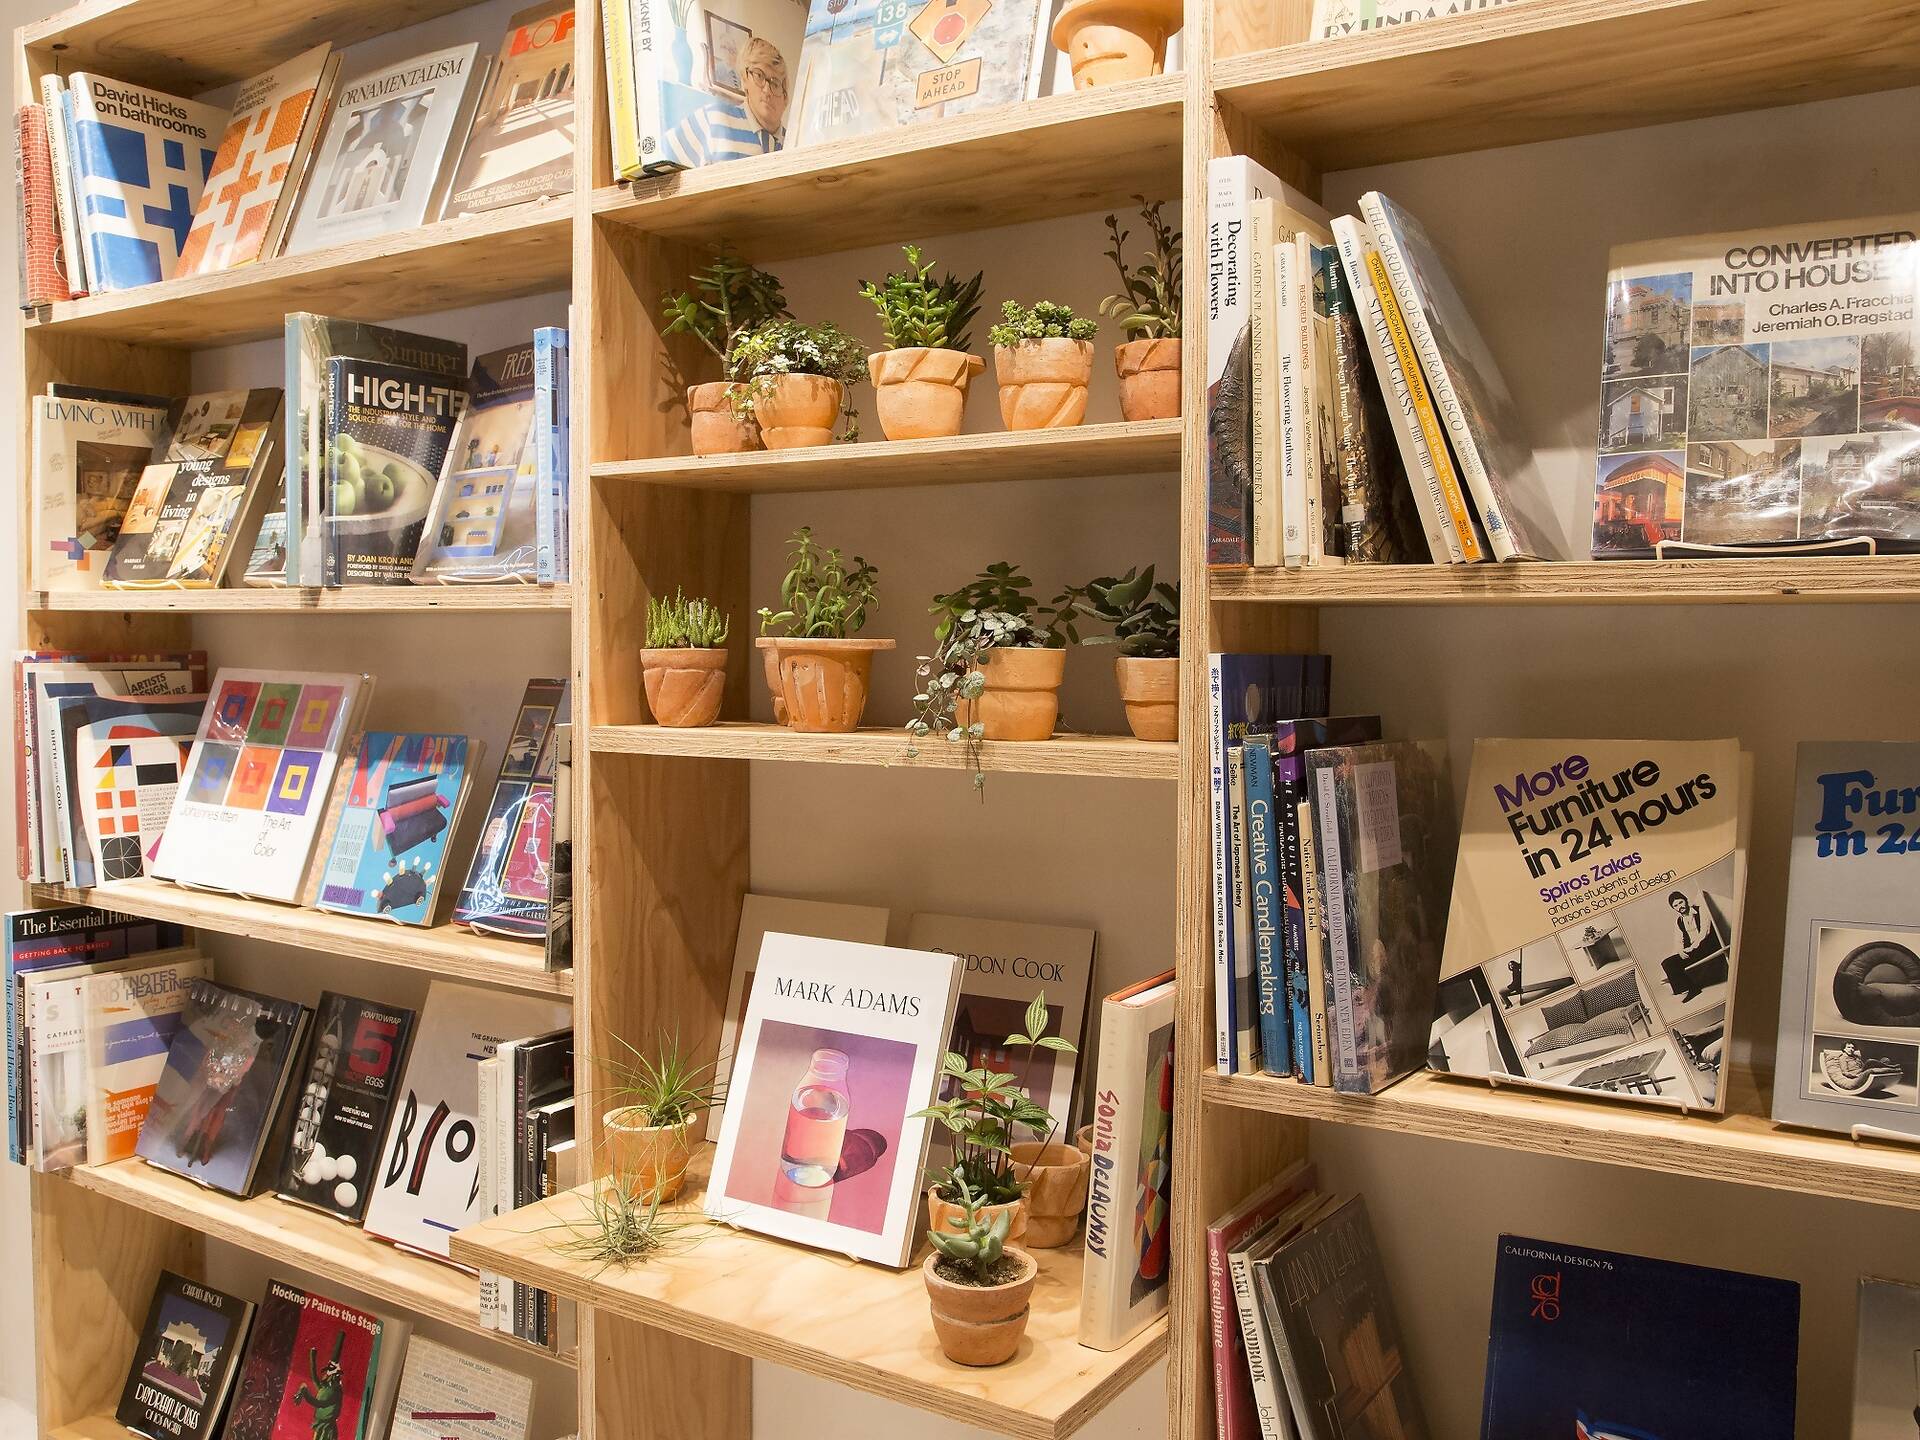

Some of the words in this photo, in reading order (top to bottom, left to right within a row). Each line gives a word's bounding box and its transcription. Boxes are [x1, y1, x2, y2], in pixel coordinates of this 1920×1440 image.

[876, 2, 907, 24] 138
[338, 57, 464, 108] ORNAMENTALISM
[922, 82, 965, 101] AHEAD
[932, 69, 961, 85] STOP
[93, 82, 140, 106] David
[142, 95, 187, 119] Hicks
[95, 101, 116, 116] on
[119, 105, 207, 139] bathrooms
[1367, 206, 1384, 231] THE
[1210, 222, 1223, 259] with
[1223, 220, 1242, 306] Decorating
[1252, 252, 1263, 299] GARDEN
[1329, 260, 1339, 290] Martin
[1342, 238, 1354, 259] Tiny
[1348, 260, 1362, 289] Houses
[1379, 233, 1411, 298] GARDENS
[1210, 261, 1224, 321] Flowers
[1710, 271, 1779, 296] INTO
[1299, 284, 1308, 323] RESCUED
[1404, 300, 1420, 318] OF
[1769, 300, 1827, 317] Charles
[1829, 299, 1844, 311] A.
[1846, 293, 1914, 310] Fracchia
[1252, 302, 1263, 360] PLANNING
[1331, 299, 1347, 355] Approaching
[1411, 321, 1433, 351] SAN
[1752, 317, 1823, 334] Jeremiah
[1824, 314, 1840, 328] O.
[1842, 308, 1914, 326] Bragstad
[381, 332, 461, 375] Summer
[1300, 325, 1309, 370] BUILDINGS
[1253, 362, 1263, 383] FOR
[1282, 354, 1292, 373] The
[1336, 355, 1348, 384] Design
[1372, 257, 1387, 292] CHARLES
[1404, 361, 1425, 402] KAUFFMAN
[1424, 419, 1436, 434] THIS
[1431, 444, 1447, 470] WHERE
[1440, 471, 1452, 488] YOU
[1253, 386, 1263, 407] THE
[1282, 375, 1293, 426] Flowering
[1337, 384, 1351, 422] Through
[1424, 352, 1463, 432] FRANCISCO
[46, 402, 105, 425] LIVING
[111, 409, 155, 431] WITH
[348, 405, 361, 414] THE
[401, 412, 420, 422] STYLE
[422, 415, 436, 424] AND
[348, 414, 376, 425] SOURCE
[426, 424, 447, 433] HOME
[1366, 297, 1401, 366] STAINED
[1387, 367, 1414, 416] GLASS
[1409, 425, 1422, 444] Hill
[1417, 451, 1430, 469] Hill
[1425, 475, 1451, 529] Halberstadt
[1254, 410, 1264, 448] SMALL
[1342, 424, 1353, 452] Nature
[178, 458, 214, 474] young
[1284, 427, 1294, 477] Southwest
[1345, 455, 1356, 472] The
[192, 473, 230, 487] designs
[1254, 450, 1264, 506] PROPERTY
[1345, 472, 1358, 495] Quiet
[185, 489, 197, 503] in
[161, 504, 192, 520] living
[1347, 521, 1360, 553] Viking
[347, 554, 356, 562] BY
[356, 554, 378, 564] JOAN
[378, 555, 398, 565] KRON
[131, 672, 166, 693] ARTISTS
[50, 729, 58, 760] BIRTH
[1248, 749, 1258, 788] NEWMAN
[1285, 770, 1293, 795] THE
[1493, 754, 1591, 813] More
[1232, 805, 1240, 818] The
[1286, 803, 1294, 826] ART
[1507, 759, 1661, 845] Furniture
[1233, 820, 1241, 833] Art
[1234, 833, 1241, 842] of
[1250, 799, 1267, 875] Creative
[1522, 847, 1559, 880] in
[1560, 816, 1613, 863] 24
[1615, 771, 1718, 841] hours
[1287, 834, 1297, 878] QUILT
[1303, 838, 1313, 869] Native
[1816, 827, 1868, 858] in
[1233, 843, 1242, 879] Japanese
[1327, 847, 1341, 901] CALIFORNIA
[1305, 871, 1315, 895] Funk
[1539, 870, 1592, 904] Spiros
[1592, 850, 1643, 883] Zakas
[1234, 880, 1242, 908] Joinery
[1547, 903, 1569, 918] and
[1570, 896, 1583, 908] his
[1583, 879, 1627, 902] students
[1628, 870, 1642, 882] at
[1551, 907, 1592, 928] Parsons
[1592, 889, 1629, 911] School
[1628, 885, 1640, 898] of
[1639, 866, 1677, 895] Design
[19, 917, 47, 936] The
[49, 910, 105, 934] Essential
[1307, 906, 1317, 931] Flash
[1331, 904, 1343, 946] GARDENS
[19, 950, 51, 960] GETTING
[53, 947, 73, 956] BACK
[1255, 876, 1275, 1015] Candlemaking
[1011, 956, 1066, 983] COOK
[1333, 948, 1347, 994] CREATING
[6, 976, 14, 998] The
[773, 976, 834, 1006] MARK
[842, 986, 921, 1018] ADAMS
[6, 1001, 15, 1053] Essential
[1339, 1005, 1350, 1023] NEW
[348, 1018, 398, 1078] 5
[1314, 1012, 1326, 1062] Scrimshaw
[1342, 1026, 1352, 1051] EDEN
[7, 1056, 16, 1091] House
[364, 1075, 385, 1088] EGGS
[8, 1093, 16, 1121] Book
[1094, 1088, 1121, 1155] Sonia
[1086, 1149, 1114, 1262] DELAUNAY
[1210, 1248, 1223, 1278] soft
[1505, 1245, 1561, 1262] CALIFORNIA
[1564, 1255, 1601, 1269] DESIGN
[1602, 1261, 1614, 1271] 76
[1231, 1259, 1250, 1299] RAKU
[271, 1283, 312, 1310] Hockney
[311, 1295, 339, 1318] Paints
[340, 1306, 356, 1321] the
[356, 1309, 382, 1336] Stage
[1209, 1280, 1226, 1349] sculpture
[1240, 1308, 1267, 1384] HANDBOOK
[459, 1358, 475, 1369] FRANK
[475, 1363, 492, 1375] ISRAEL
[135, 1382, 176, 1416] DAYDREAM
[174, 1403, 201, 1431] HOUSES
[1259, 1403, 1273, 1433] John
